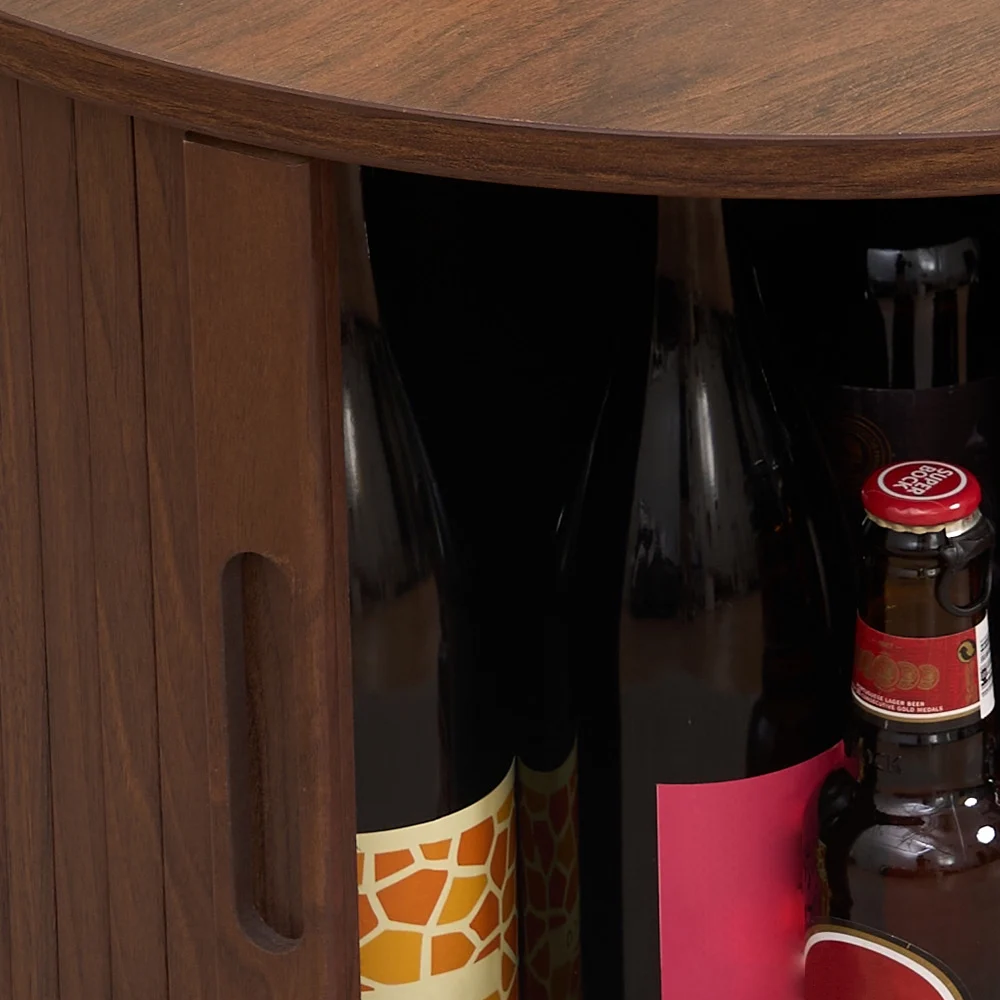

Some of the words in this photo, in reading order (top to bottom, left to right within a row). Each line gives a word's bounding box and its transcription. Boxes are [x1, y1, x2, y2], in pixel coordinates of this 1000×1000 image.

[892, 465, 936, 493] BOCK
[906, 467, 954, 495] SUPER
[884, 697, 905, 707] LAGER
[917, 705, 944, 713] MEDALS
